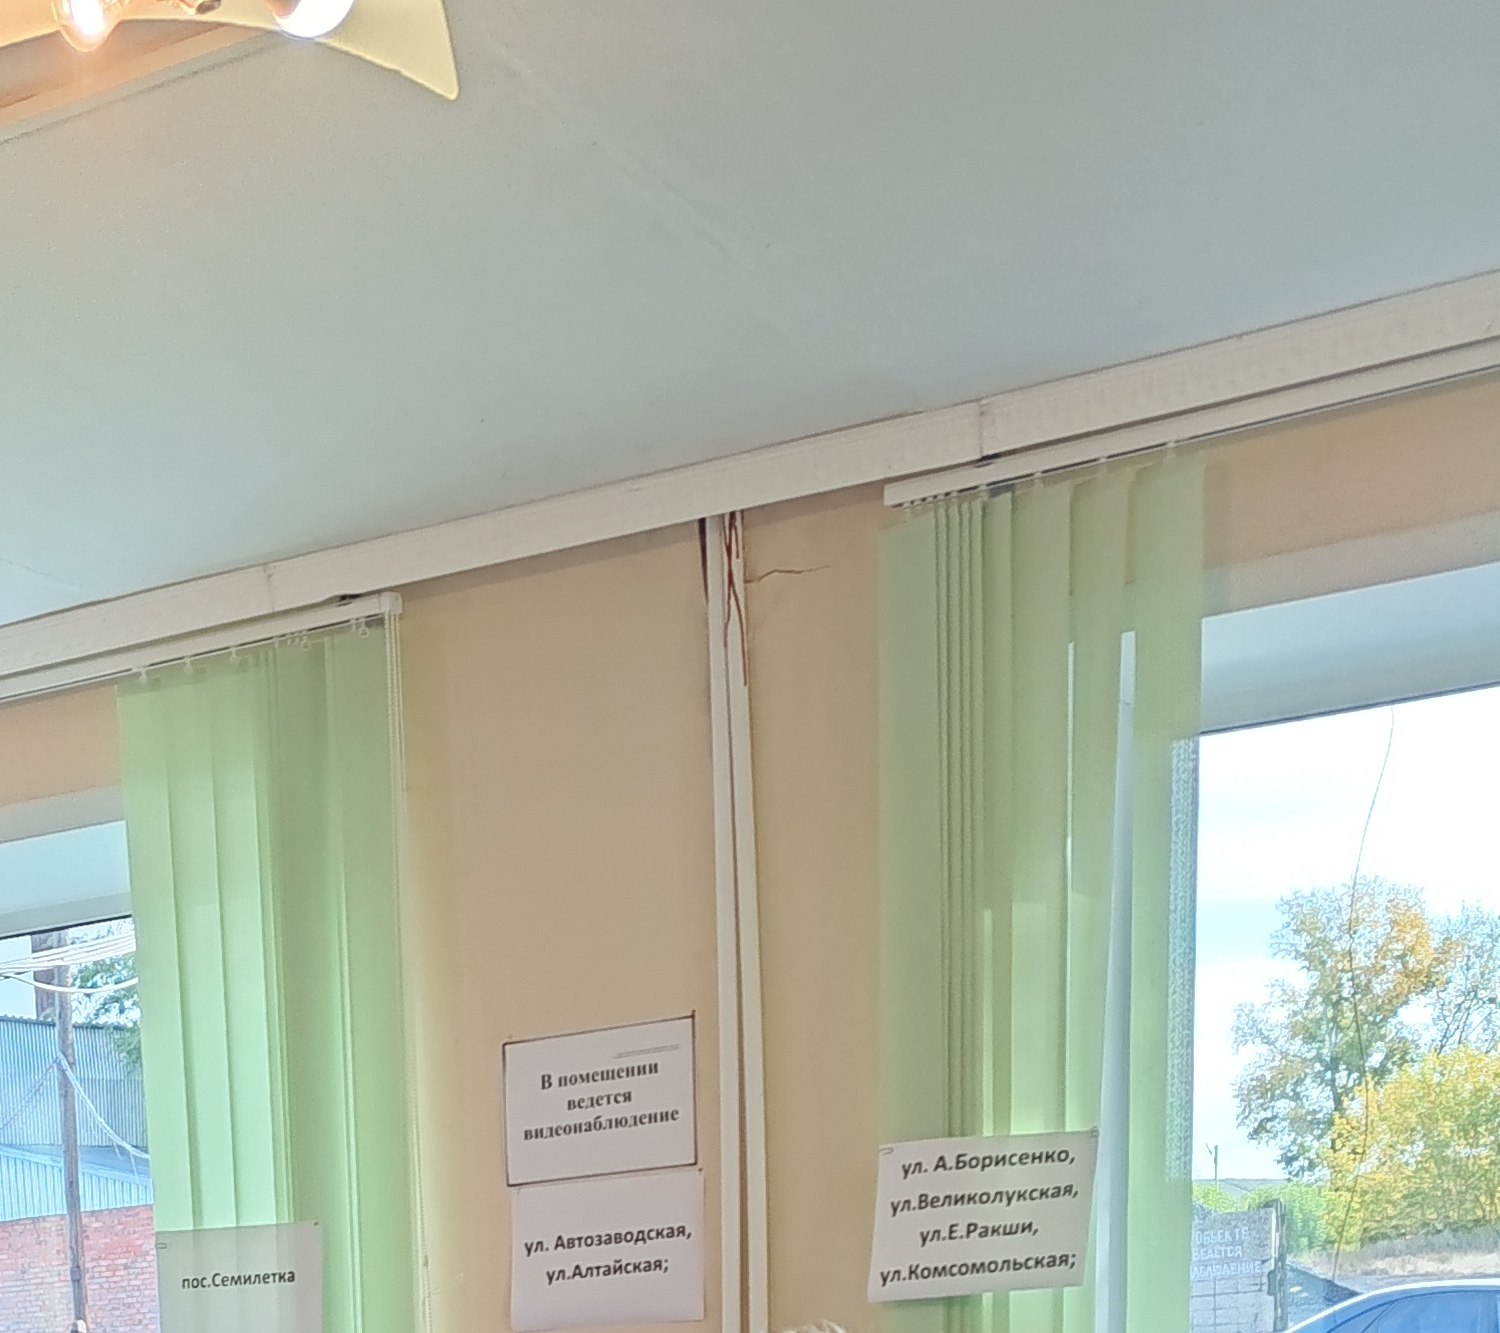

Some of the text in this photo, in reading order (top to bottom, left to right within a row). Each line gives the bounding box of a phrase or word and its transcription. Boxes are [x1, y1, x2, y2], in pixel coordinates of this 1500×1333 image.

[540, 1061, 659, 1090] В помещении
[566, 1090, 632, 1112] ведется
[523, 1108, 680, 1142] видеонаблюдение
[901, 1148, 1076, 1180] ул. А.Борисенко,
[890, 1183, 1079, 1217] ул.Великолукская,
[524, 1224, 692, 1257] ул. Автозаводская,
[919, 1220, 1039, 1247] ул.Е.Ракши,
[181, 1270, 296, 1290] пос.Семилетка
[546, 1258, 669, 1285] ул.Алтайская;
[879, 1253, 1077, 1287] ул.Комсомольская;
